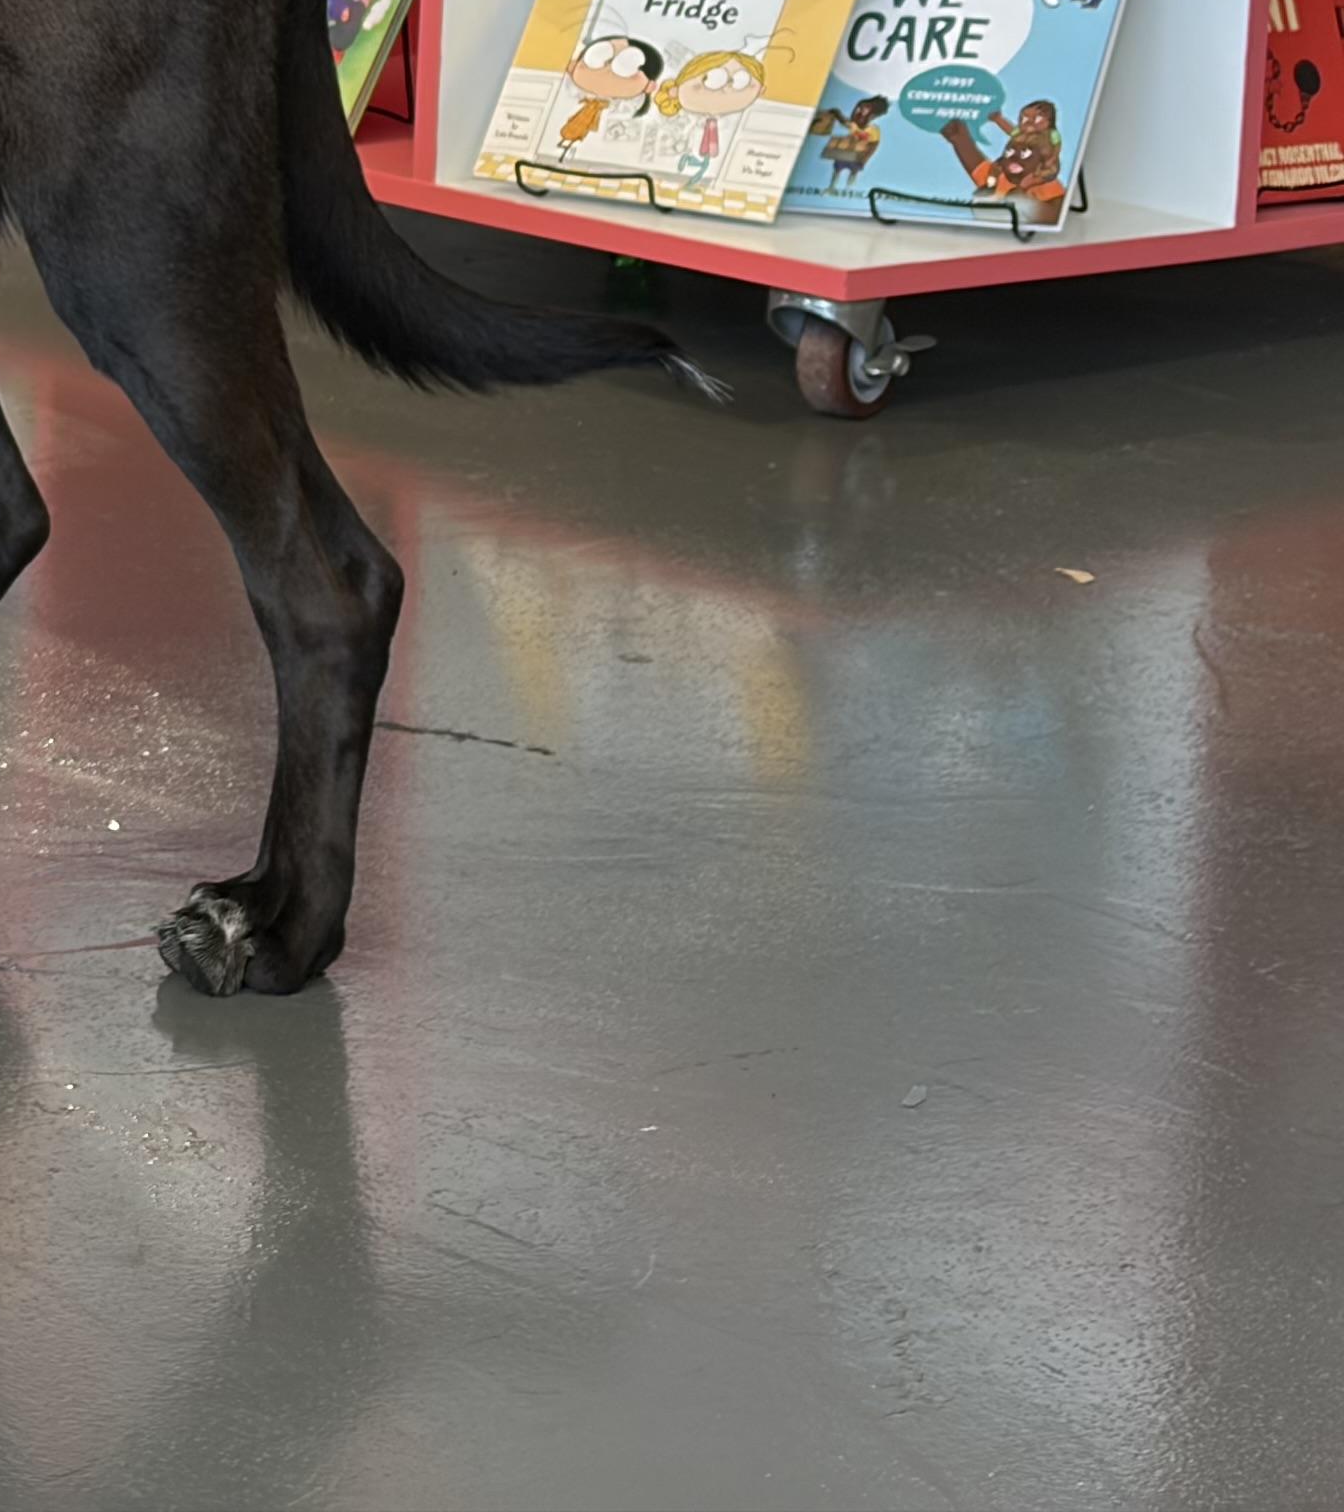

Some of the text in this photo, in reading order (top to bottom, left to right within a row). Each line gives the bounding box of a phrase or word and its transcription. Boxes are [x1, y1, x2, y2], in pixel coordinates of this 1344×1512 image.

[845, 10, 992, 63] CARE
[941, 76, 976, 88] FIRST
[906, 89, 992, 105] CONVERSATION
[934, 107, 981, 122] JUSTICE
